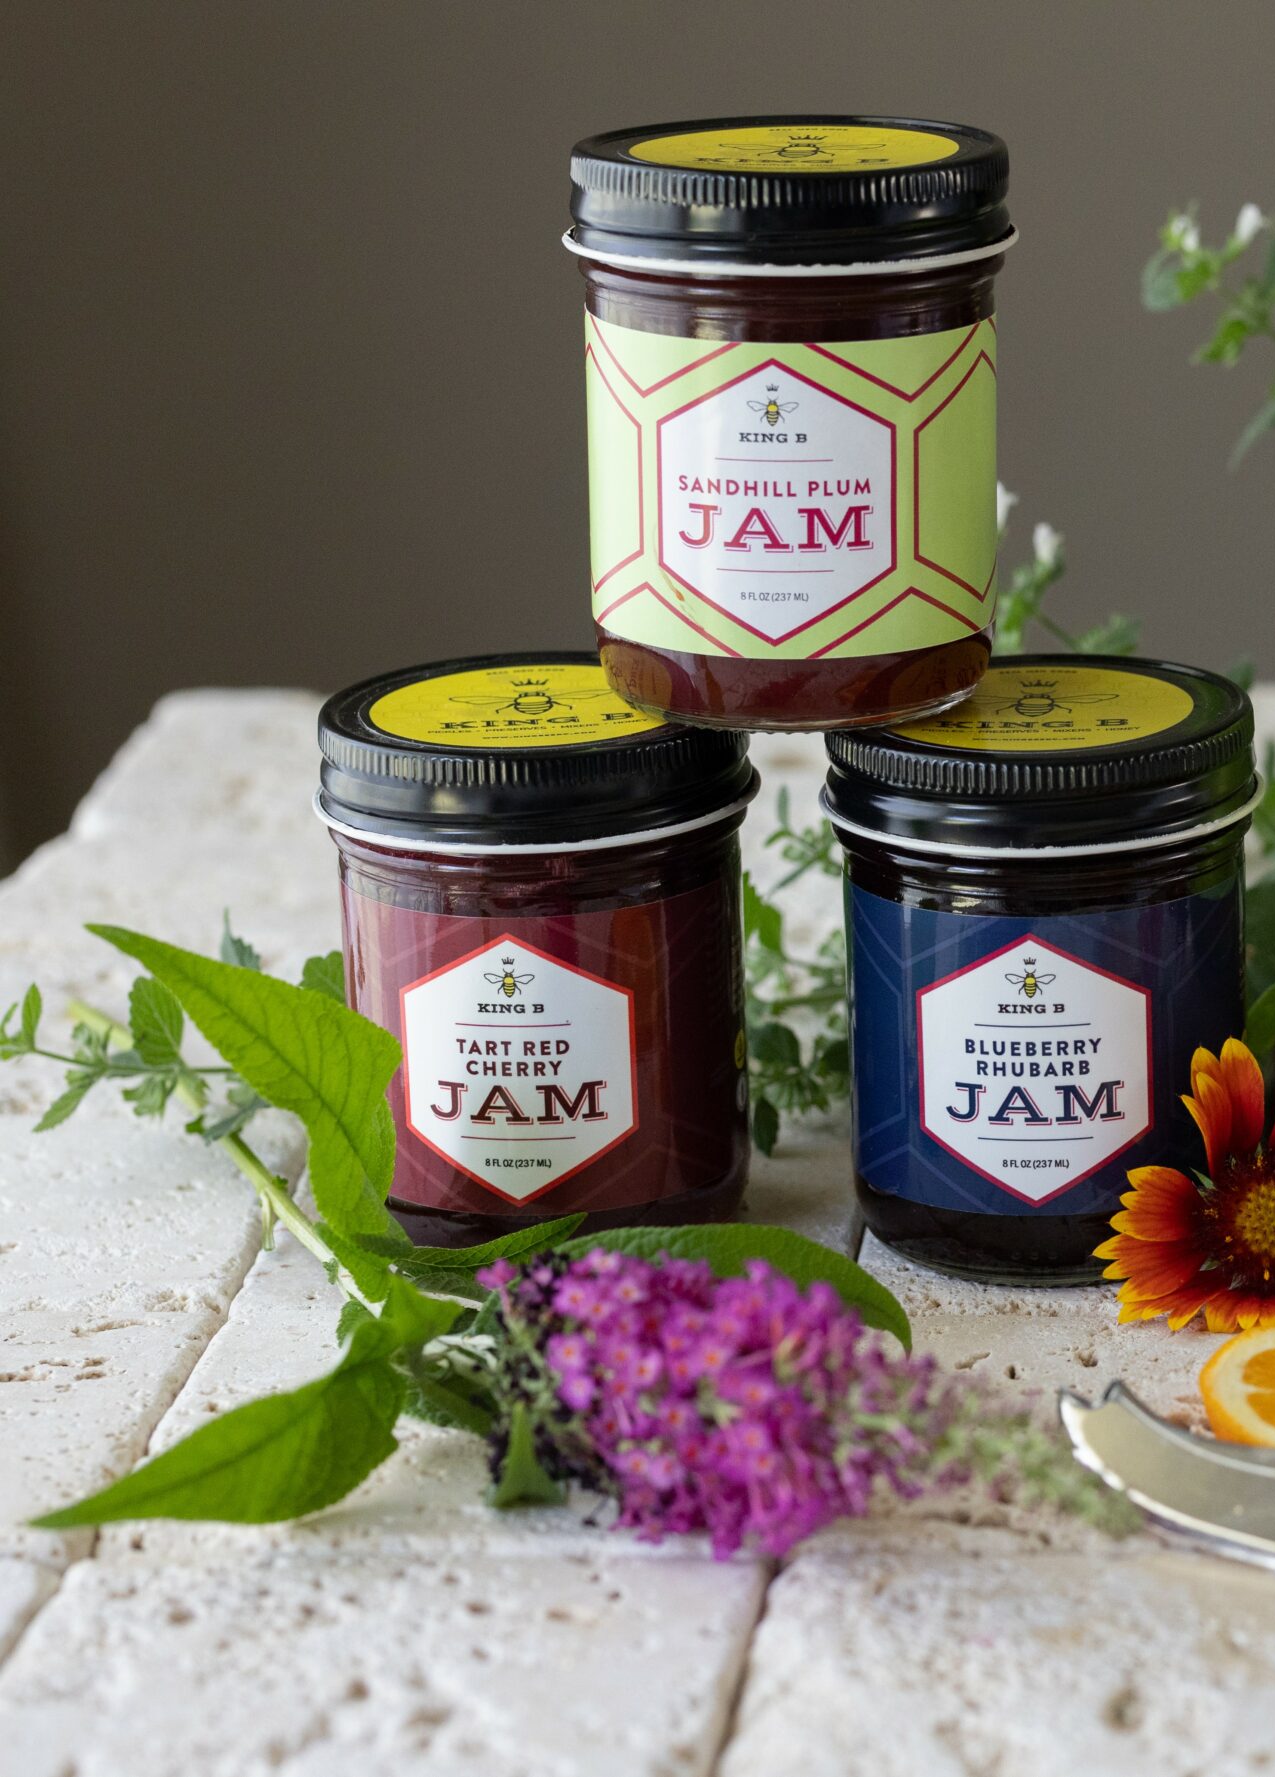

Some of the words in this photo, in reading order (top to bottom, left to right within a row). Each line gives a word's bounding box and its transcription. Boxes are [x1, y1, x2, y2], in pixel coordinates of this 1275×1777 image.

[738, 432, 788, 444] KING
[795, 433, 808, 444] B
[678, 474, 797, 498] SANDHILL
[808, 478, 872, 497] PLUM
[678, 502, 874, 554] JAM
[740, 592, 747, 601] 8
[748, 592, 758, 601] FL
[759, 592, 771, 602] OZ
[771, 592, 792, 603] (237
[794, 592, 809, 602] ML)
[439, 716, 580, 729] KING
[601, 712, 634, 721] B
[935, 720, 1074, 729] KING
[1096, 717, 1130, 727] B
[477, 1002, 526, 1014] KING
[532, 1003, 545, 1014] B
[997, 1003, 1046, 1014] KING
[1053, 1003, 1065, 1014] B
[455, 1038, 512, 1057] TART
[523, 1039, 570, 1057] RED
[964, 1037, 1102, 1057] BLUEBERRY
[466, 1060, 563, 1077] CHERRY
[976, 1060, 1091, 1078] RHUBARB
[430, 1080, 609, 1126] JAM
[945, 1080, 1125, 1127] JAM
[485, 1158, 491, 1167] 8
[492, 1158, 502, 1167] FL
[503, 1159, 515, 1168] OZ
[515, 1159, 535, 1169] (237
[536, 1159, 552, 1169] ML)
[1002, 1159, 1009, 1168] 8
[1010, 1159, 1019, 1169] FL
[1020, 1159, 1032, 1169] OZ
[1033, 1159, 1053, 1170] (237
[1054, 1159, 1070, 1169] ML)
